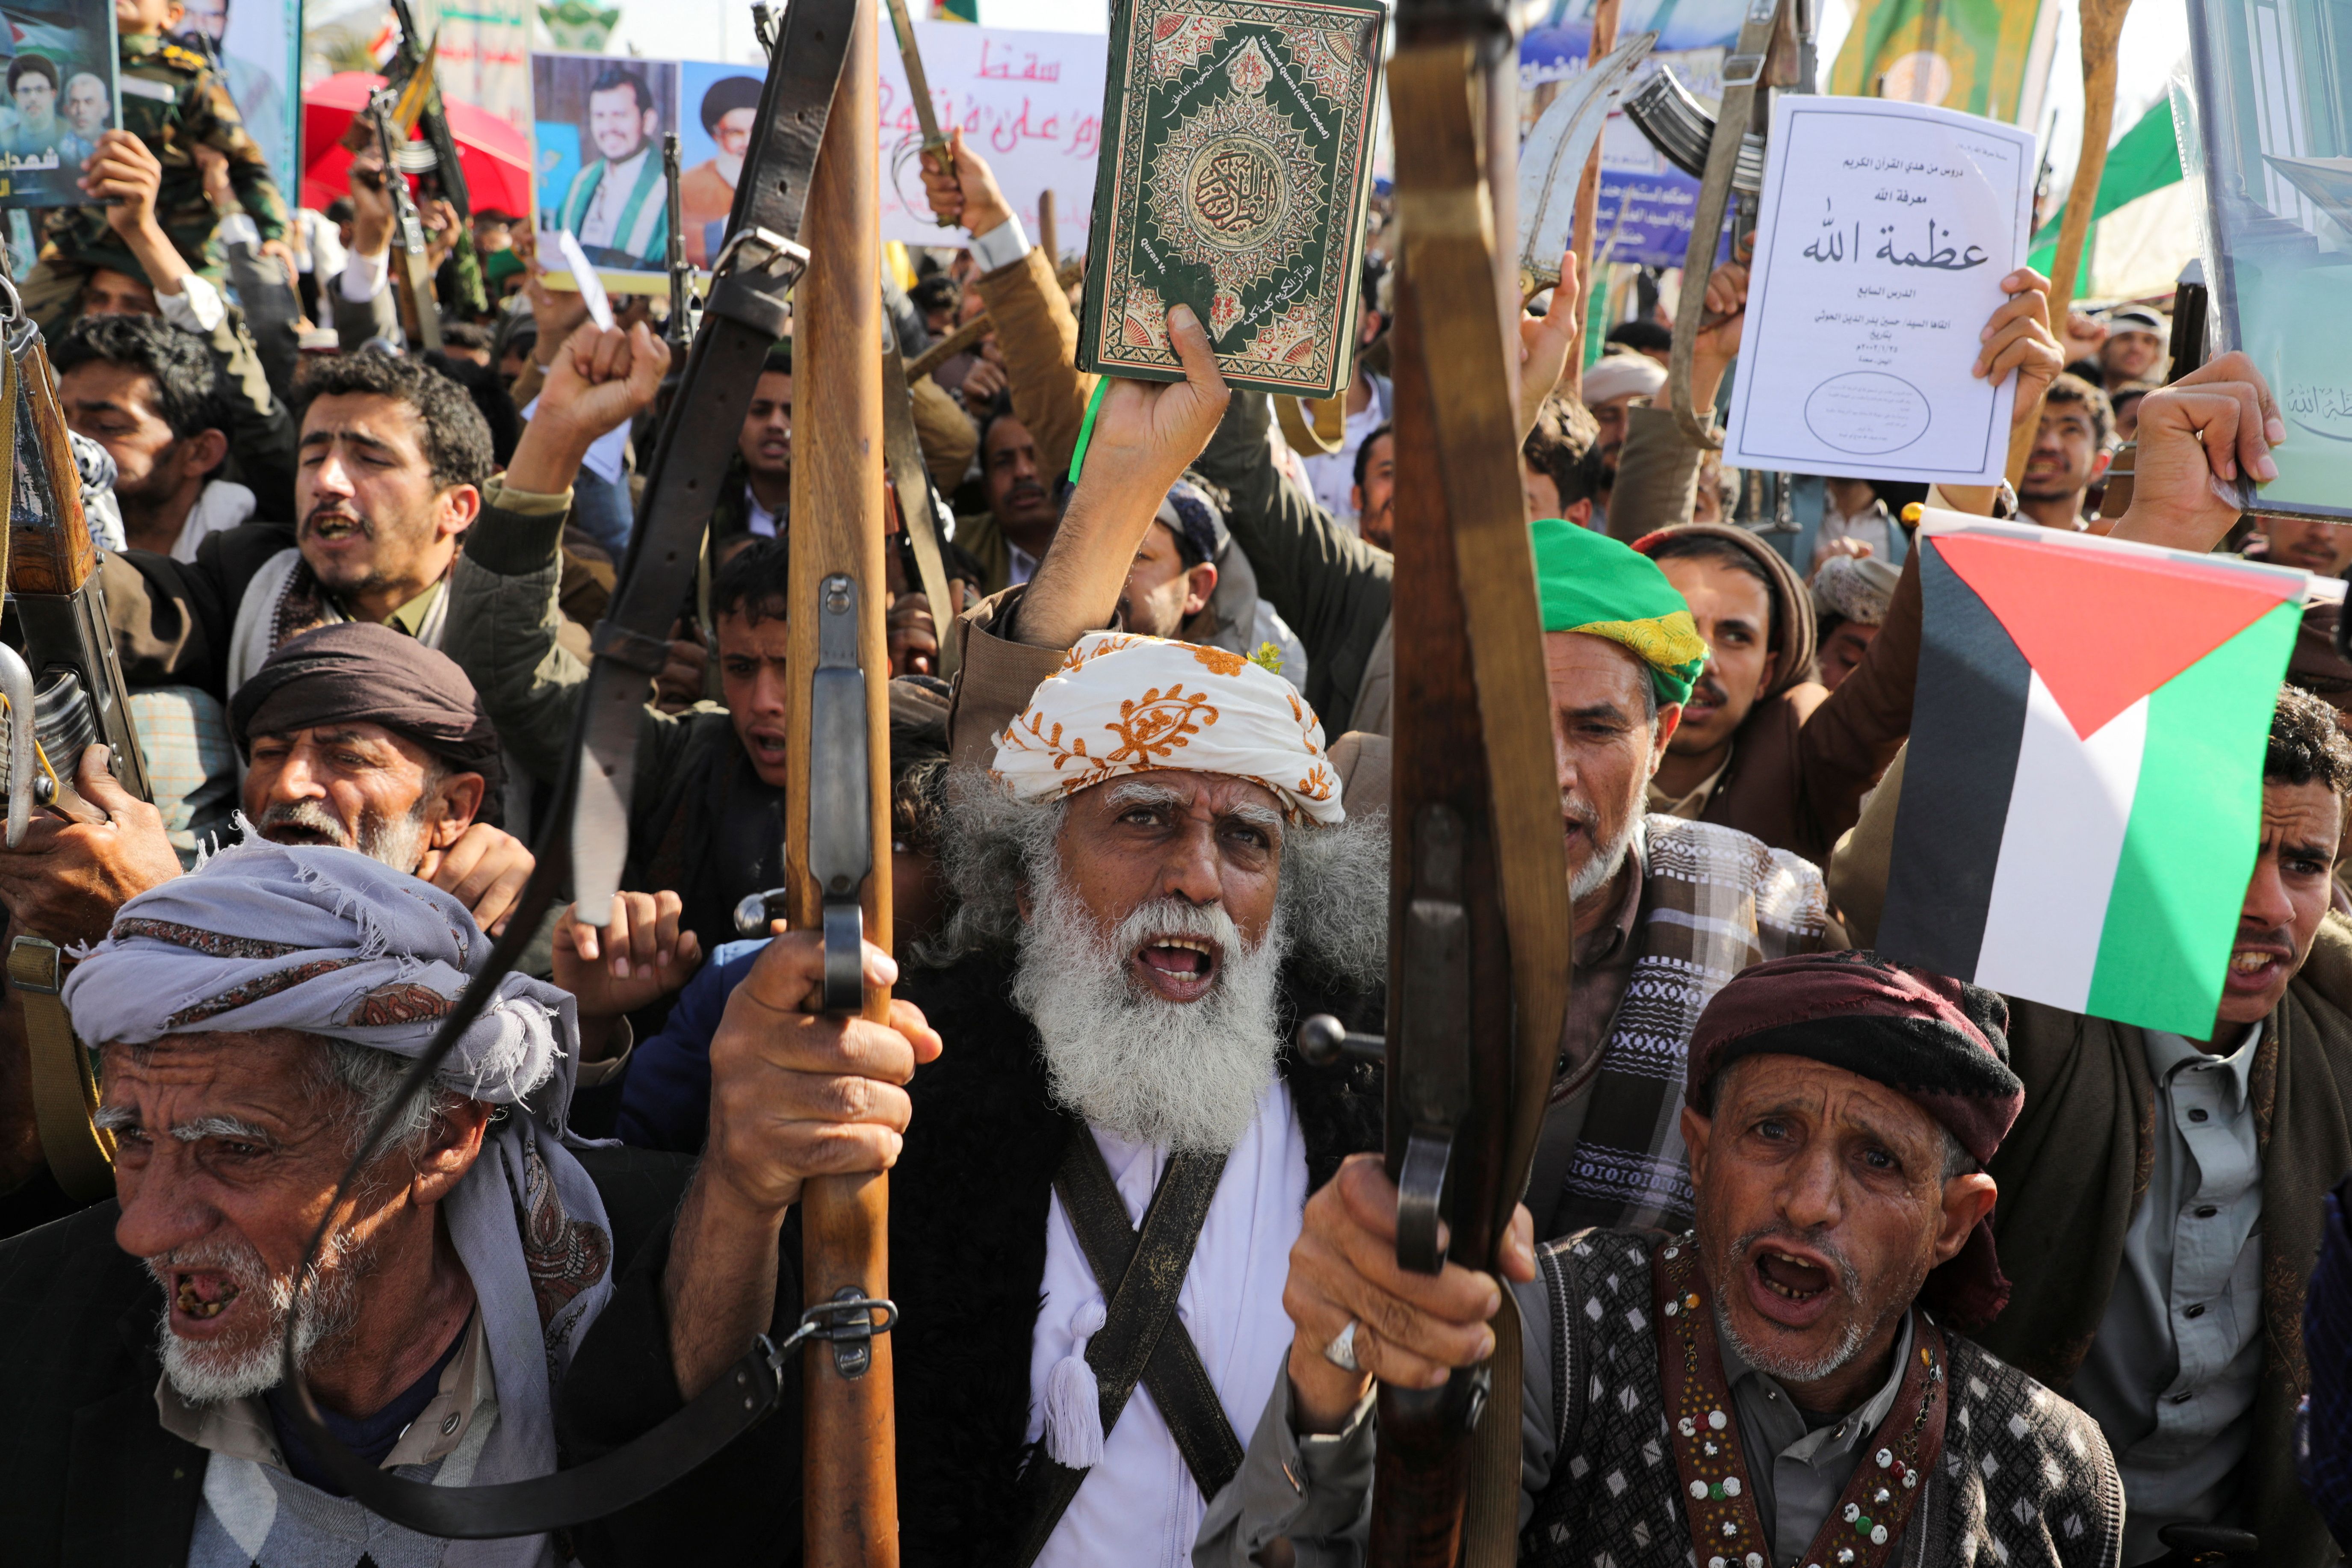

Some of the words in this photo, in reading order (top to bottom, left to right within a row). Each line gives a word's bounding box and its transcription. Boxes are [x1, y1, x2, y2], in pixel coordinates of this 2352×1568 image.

[1215, 35, 1248, 68] مصحف
[1192, 64, 1215, 88] التجويد
[1259, 35, 1283, 68] Tajweed
[1280, 67, 1297, 90] Quran
[1294, 89, 1312, 113] (Color
[1310, 112, 1330, 139] Coded)
[1843, 157, 1873, 169] الكريم
[1906, 162, 1924, 174] هدي
[1927, 166, 1938, 174] من
[1940, 169, 1963, 177] دروس
[1875, 188, 1892, 201] الله
[1897, 189, 1927, 206] معرفة
[1803, 197, 1859, 263] الله
[1141, 238, 1159, 264] Quran
[1876, 218, 1989, 271] عظمة
[1281, 264, 1315, 299] القرآن
[1275, 277, 1296, 304] الكريم
[1857, 286, 1885, 298] السابع
[1887, 289, 1916, 299] الدرس
[1257, 292, 1274, 313] كلمة
[1241, 304, 1258, 325] كلمة
[1814, 310, 1841, 322] الحوثي
[1842, 315, 1864, 325] الدين
[1865, 317, 1879, 327] بدر
[1880, 317, 1900, 327] حسين
